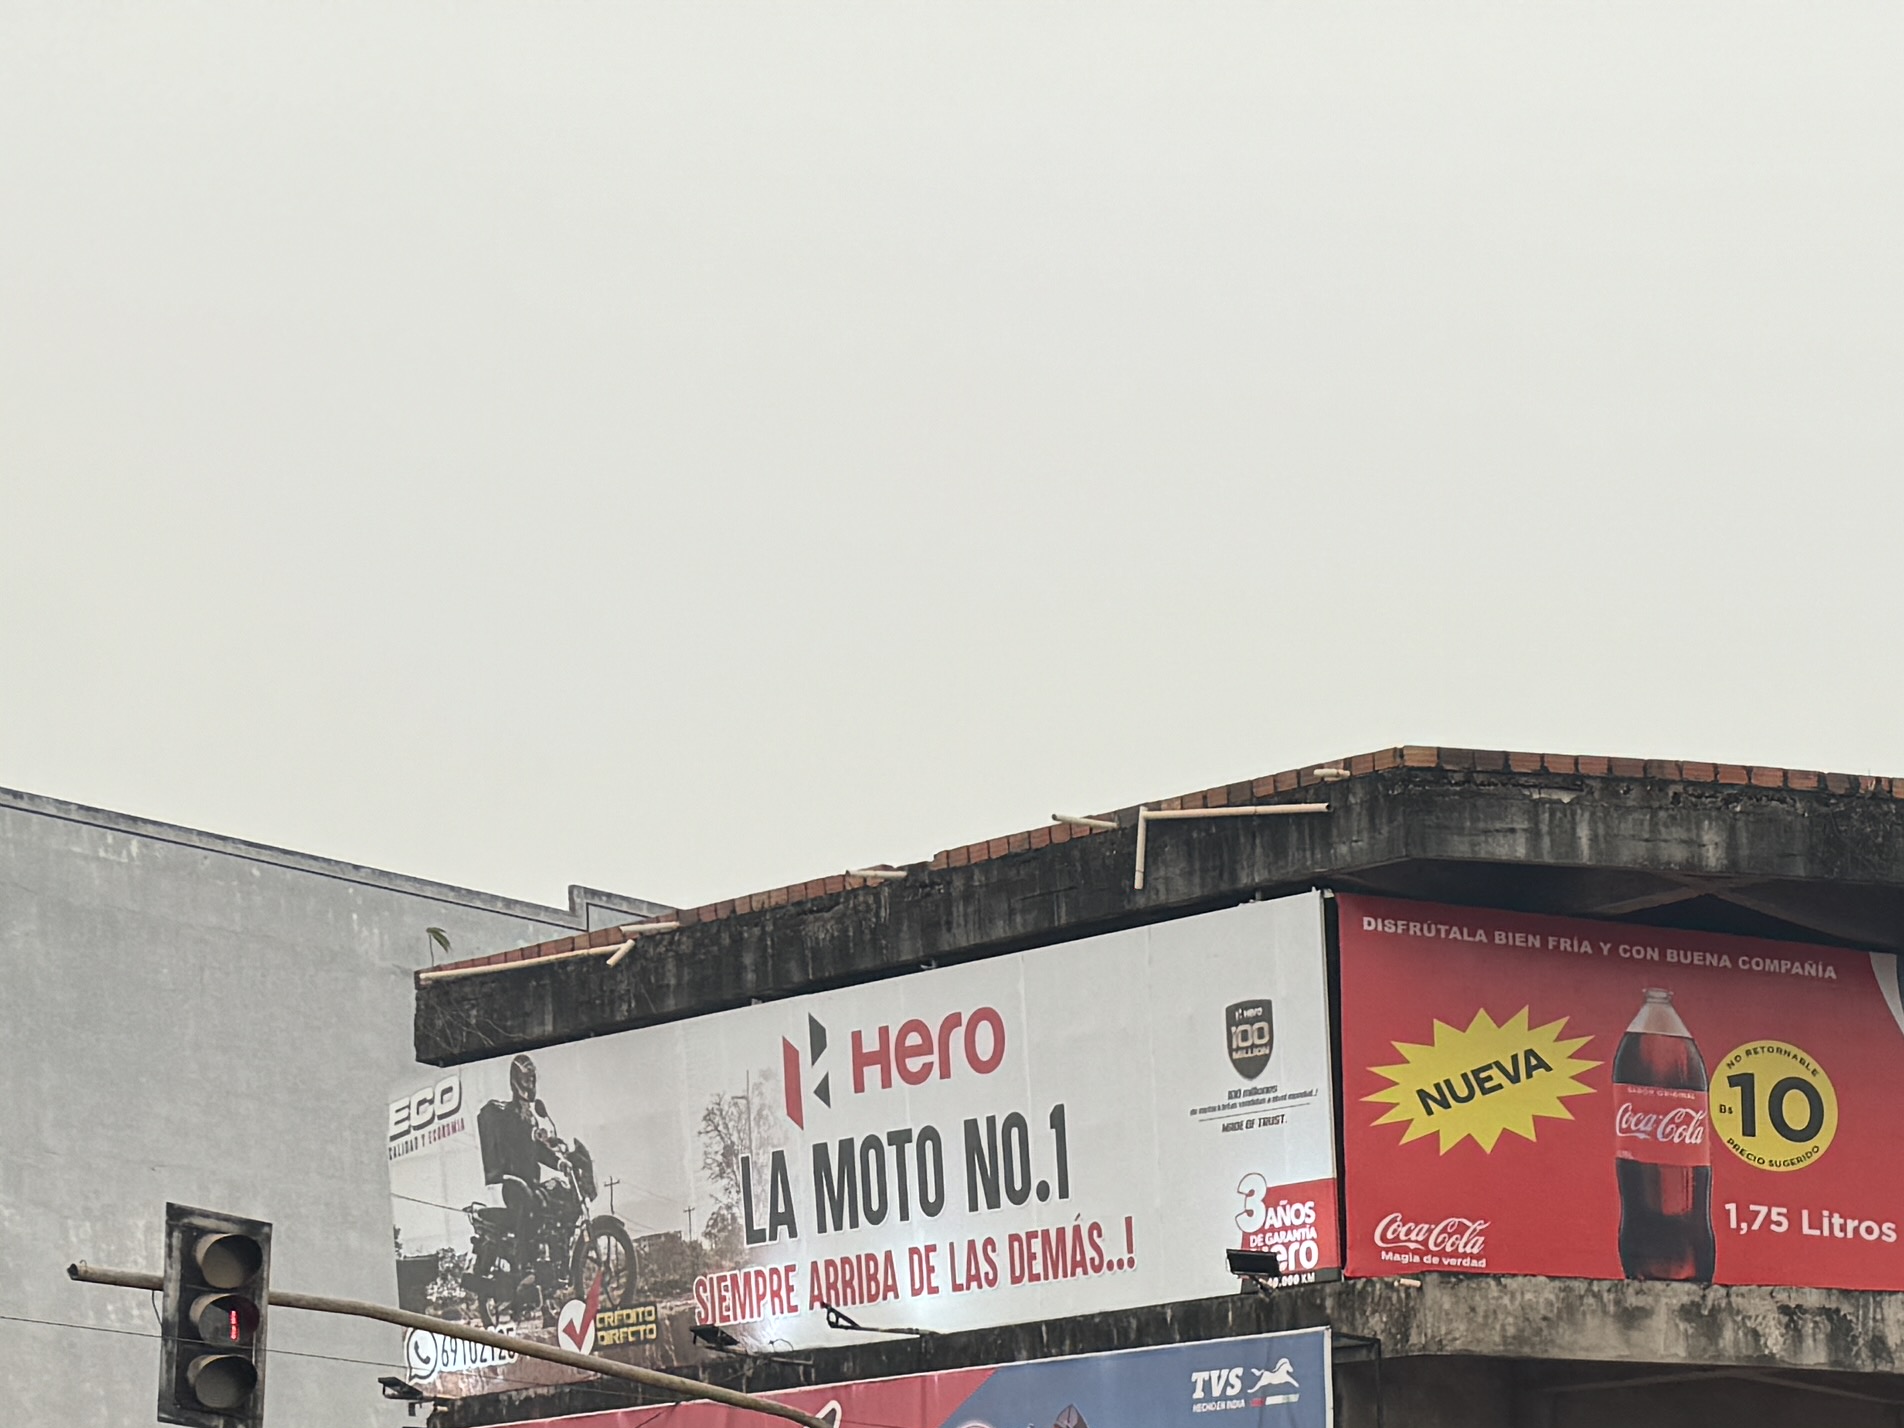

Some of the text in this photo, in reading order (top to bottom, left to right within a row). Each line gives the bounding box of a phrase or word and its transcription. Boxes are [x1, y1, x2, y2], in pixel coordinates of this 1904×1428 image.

[1362, 916, 1837, 979] DISFRÚTALA BIEN FRÍA Y CON BUENA COMPAÑÍA
[851, 1006, 1006, 1094] Hero
[1231, 1021, 1270, 1049] 100
[1416, 1047, 1554, 1116] NUEVA
[1726, 1046, 1820, 1078] NO RETORNABLE
[389, 1074, 462, 1142] ECO
[1615, 1102, 1707, 1145] Coca-Cola
[1725, 1072, 1825, 1143] 10
[1726, 1137, 1820, 1168] PRECIO SUGERIDO
[741, 1103, 1070, 1247] LA MOTO NO.1
[1235, 1172, 1316, 1234] 3 AÑOS
[1724, 1201, 1898, 1244] 1,75 Litros
[1249, 1225, 1317, 1247] DE GARANTÍA
[1374, 1213, 1491, 1254] Coca-Cola
[694, 1263, 799, 1326] SIEMPRE
[808, 1249, 899, 1311] ARRIBA
[908, 1244, 939, 1298] DE
[949, 1236, 998, 1293] LAS
[1381, 1251, 1487, 1268] Magia de verdad
[1191, 1366, 1244, 1399] TVS
